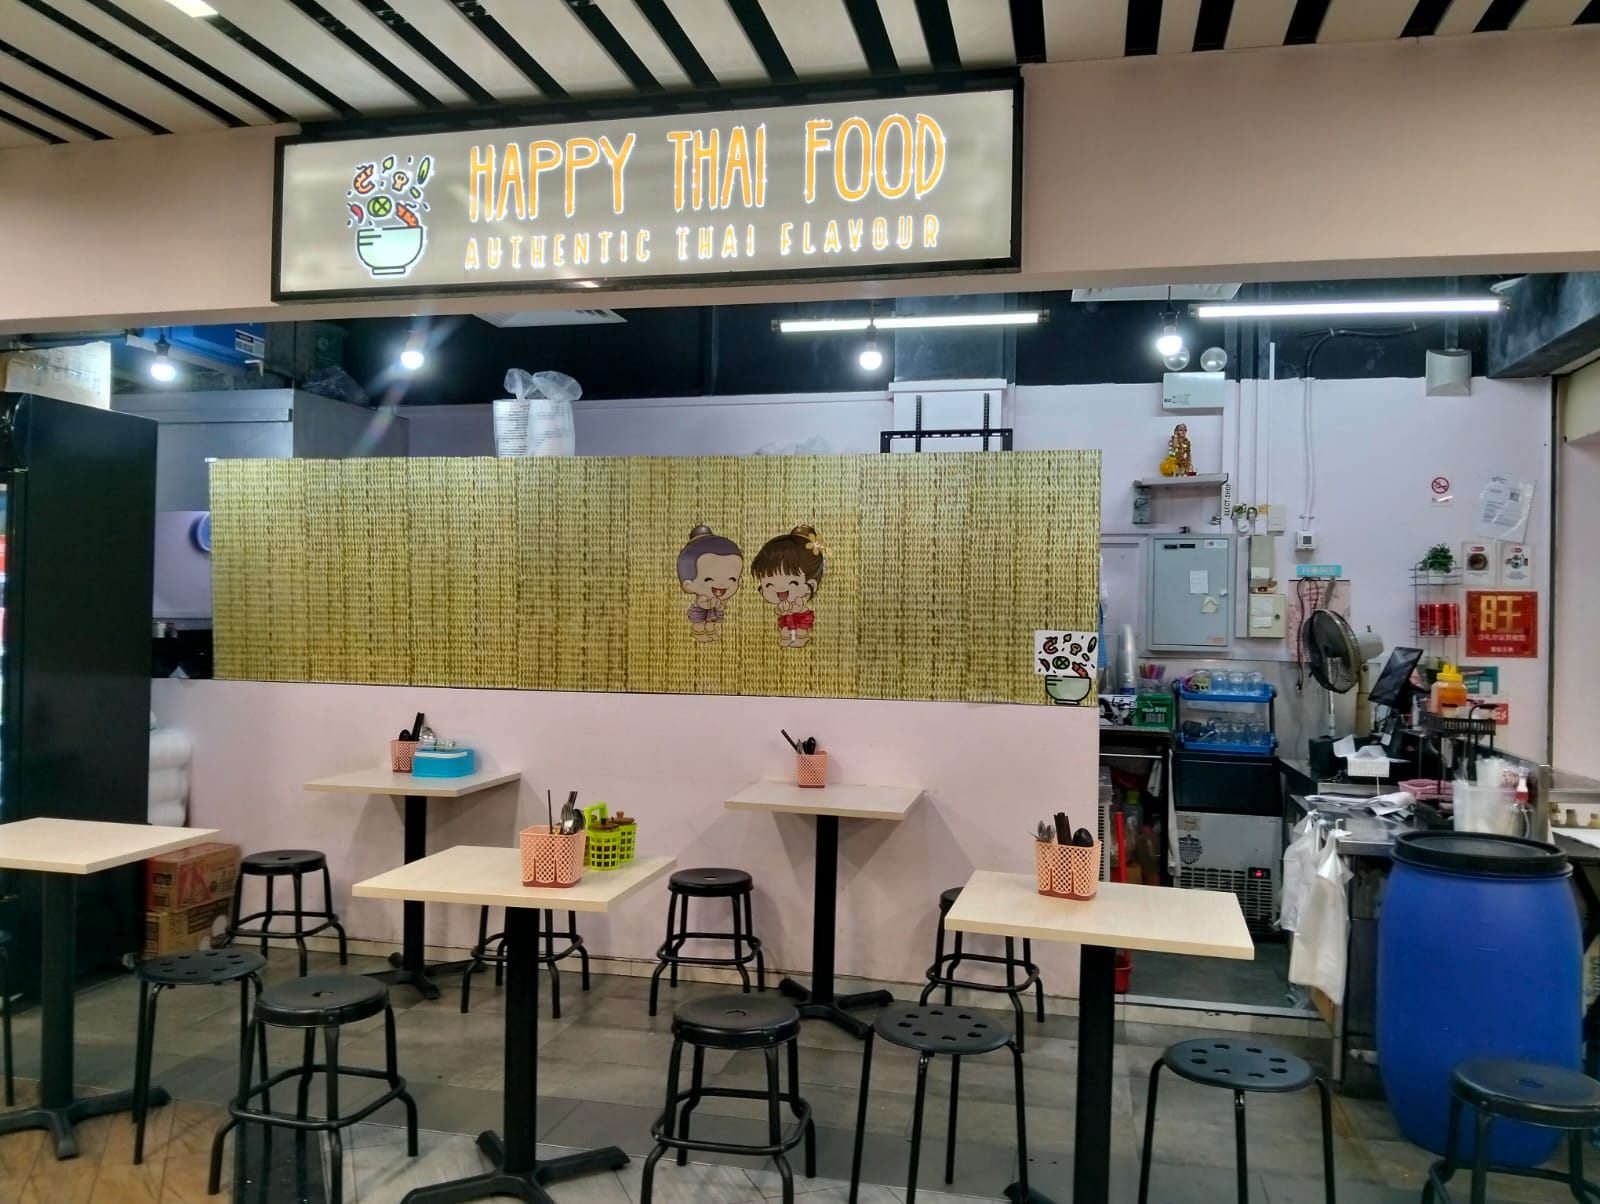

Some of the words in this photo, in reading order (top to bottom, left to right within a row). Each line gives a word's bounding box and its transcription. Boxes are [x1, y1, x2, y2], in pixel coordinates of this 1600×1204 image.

[469, 132, 636, 223] HAPPY
[666, 122, 768, 213] THAI
[803, 112, 946, 204] FOOD
[464, 227, 651, 270] AUTHENTIC
[675, 222, 756, 261] THAI
[780, 213, 940, 257] FLAVOUR
[1480, 594, 1524, 633] 旺
